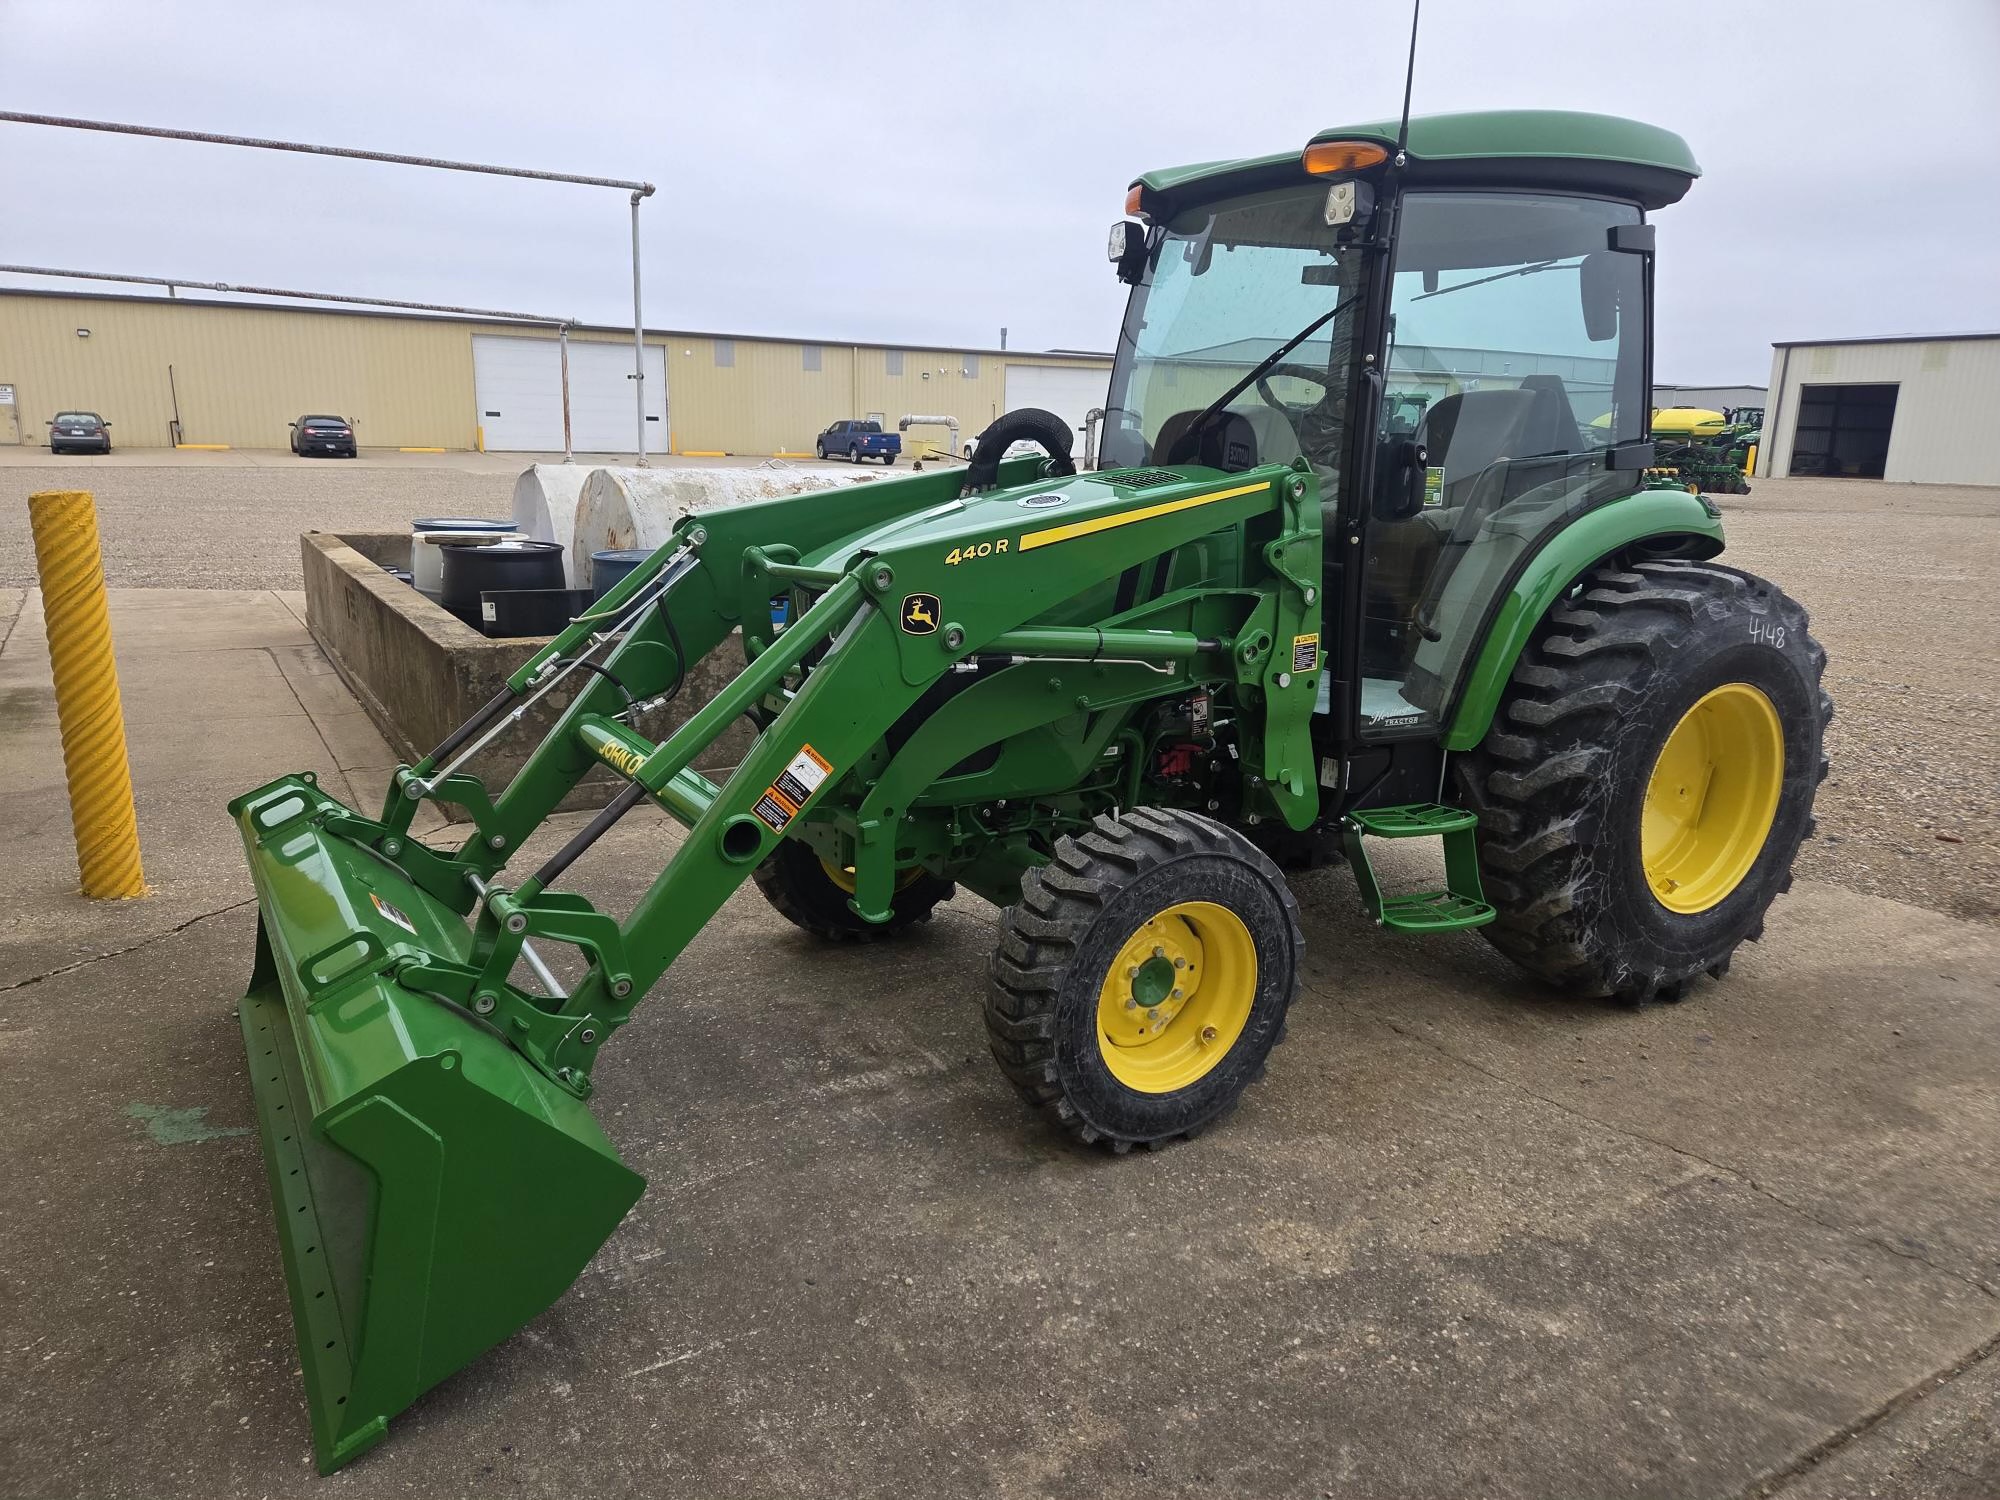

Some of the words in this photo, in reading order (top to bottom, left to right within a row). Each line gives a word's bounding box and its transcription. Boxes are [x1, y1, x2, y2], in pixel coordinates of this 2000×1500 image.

[1749, 615, 1785, 649] 4148
[1385, 716, 1419, 726] TRACTOR
[598, 741, 632, 769] JOHN
